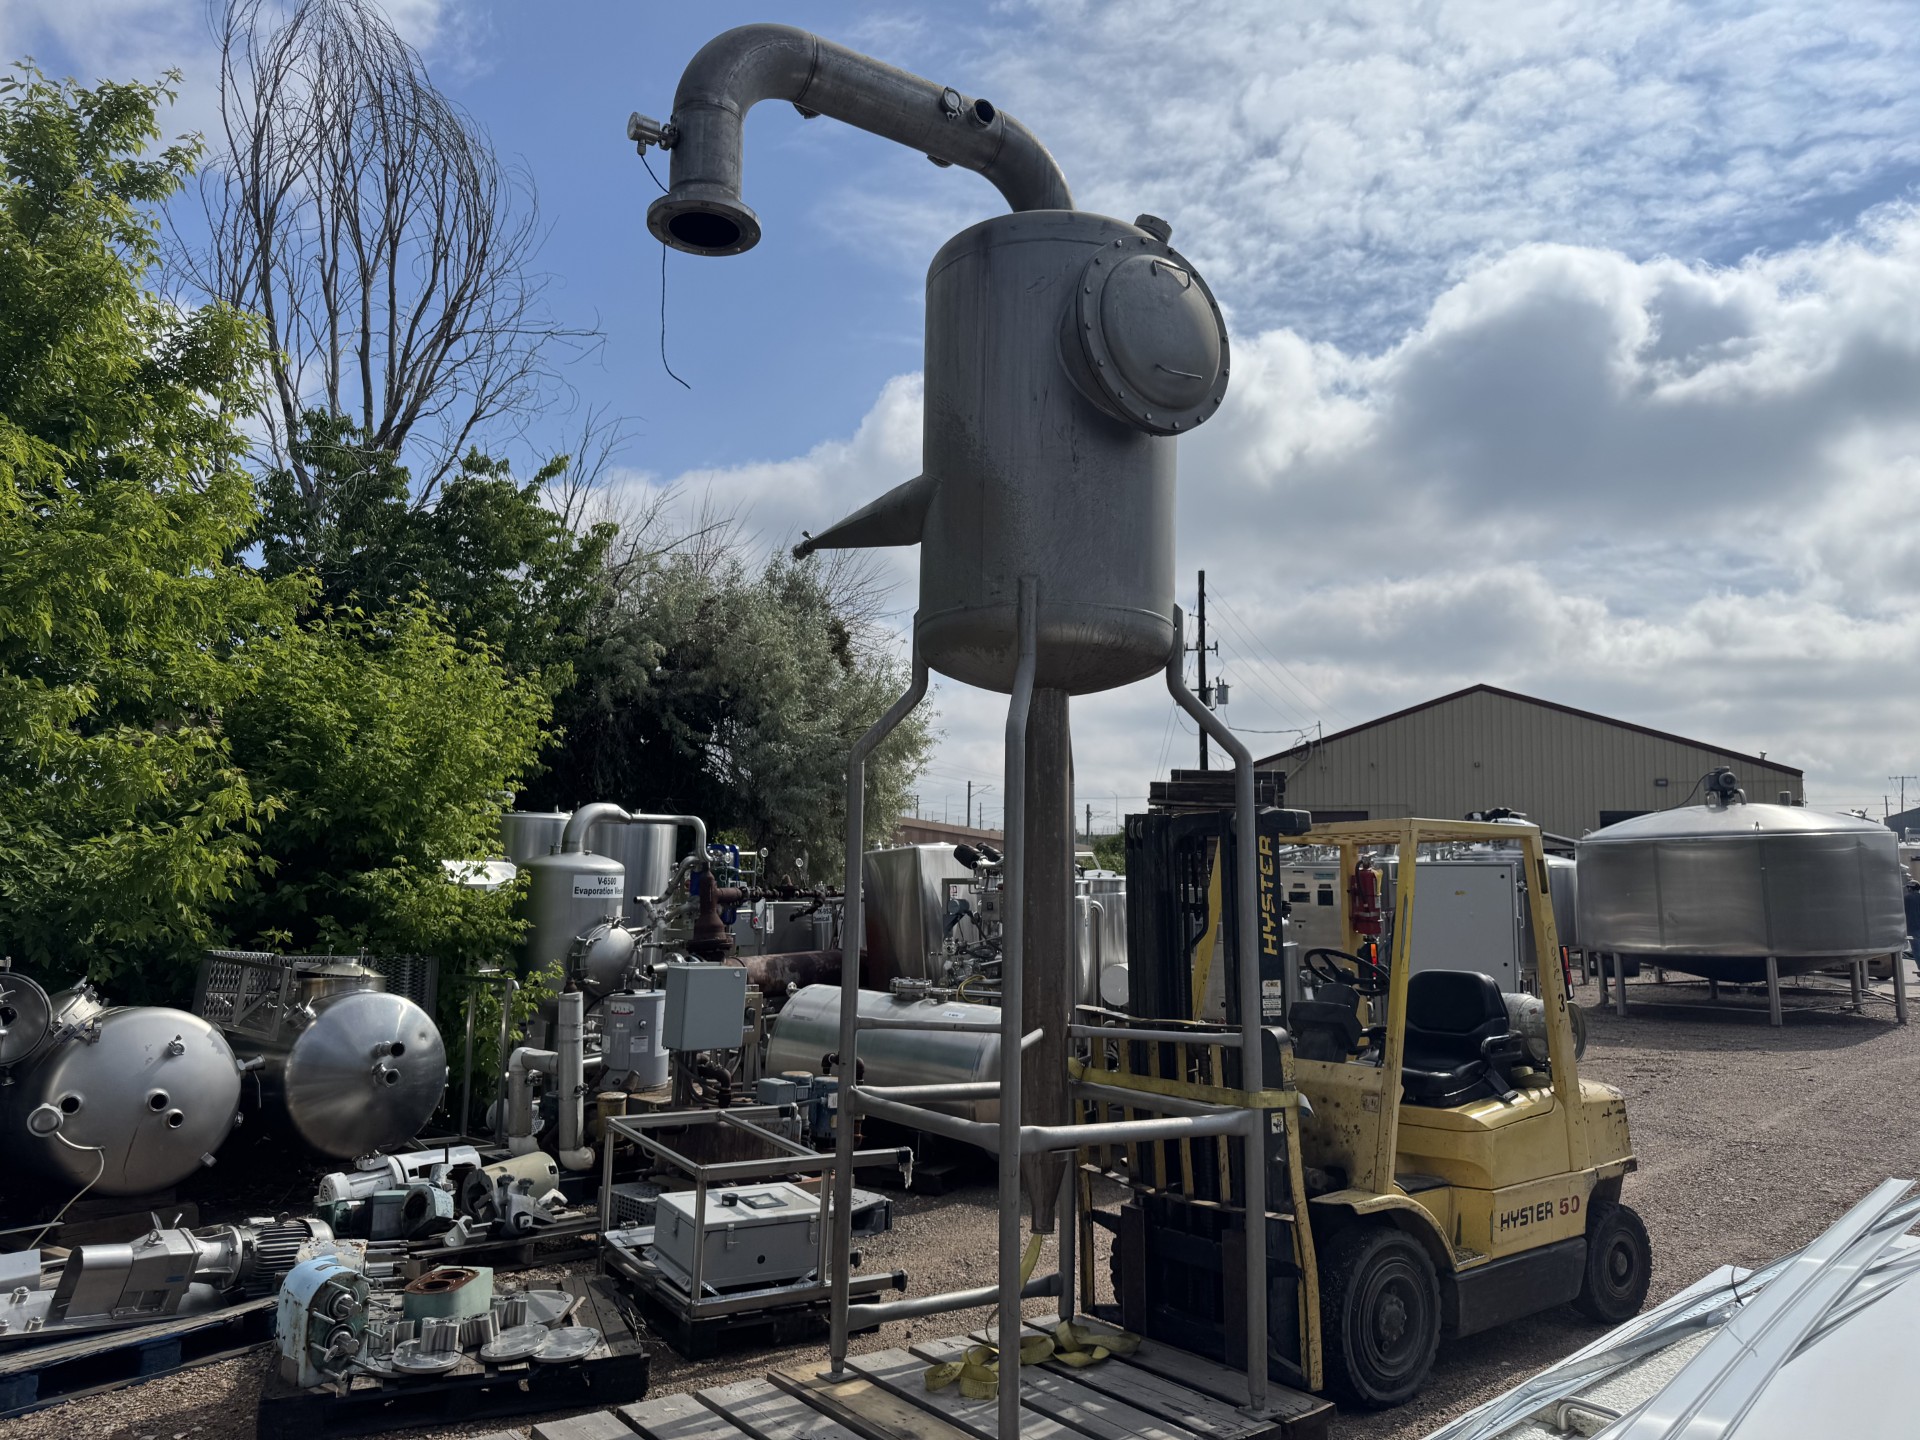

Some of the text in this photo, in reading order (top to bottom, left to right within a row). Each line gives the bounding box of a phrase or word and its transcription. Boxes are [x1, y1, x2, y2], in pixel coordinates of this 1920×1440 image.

[574, 886, 614, 897] Evaporation
[597, 877, 617, 886] V-6500
[1258, 835, 1278, 956] HYSTER
[1558, 993, 1566, 1013] 3
[1500, 1195, 1581, 1232] HYSTER 50
